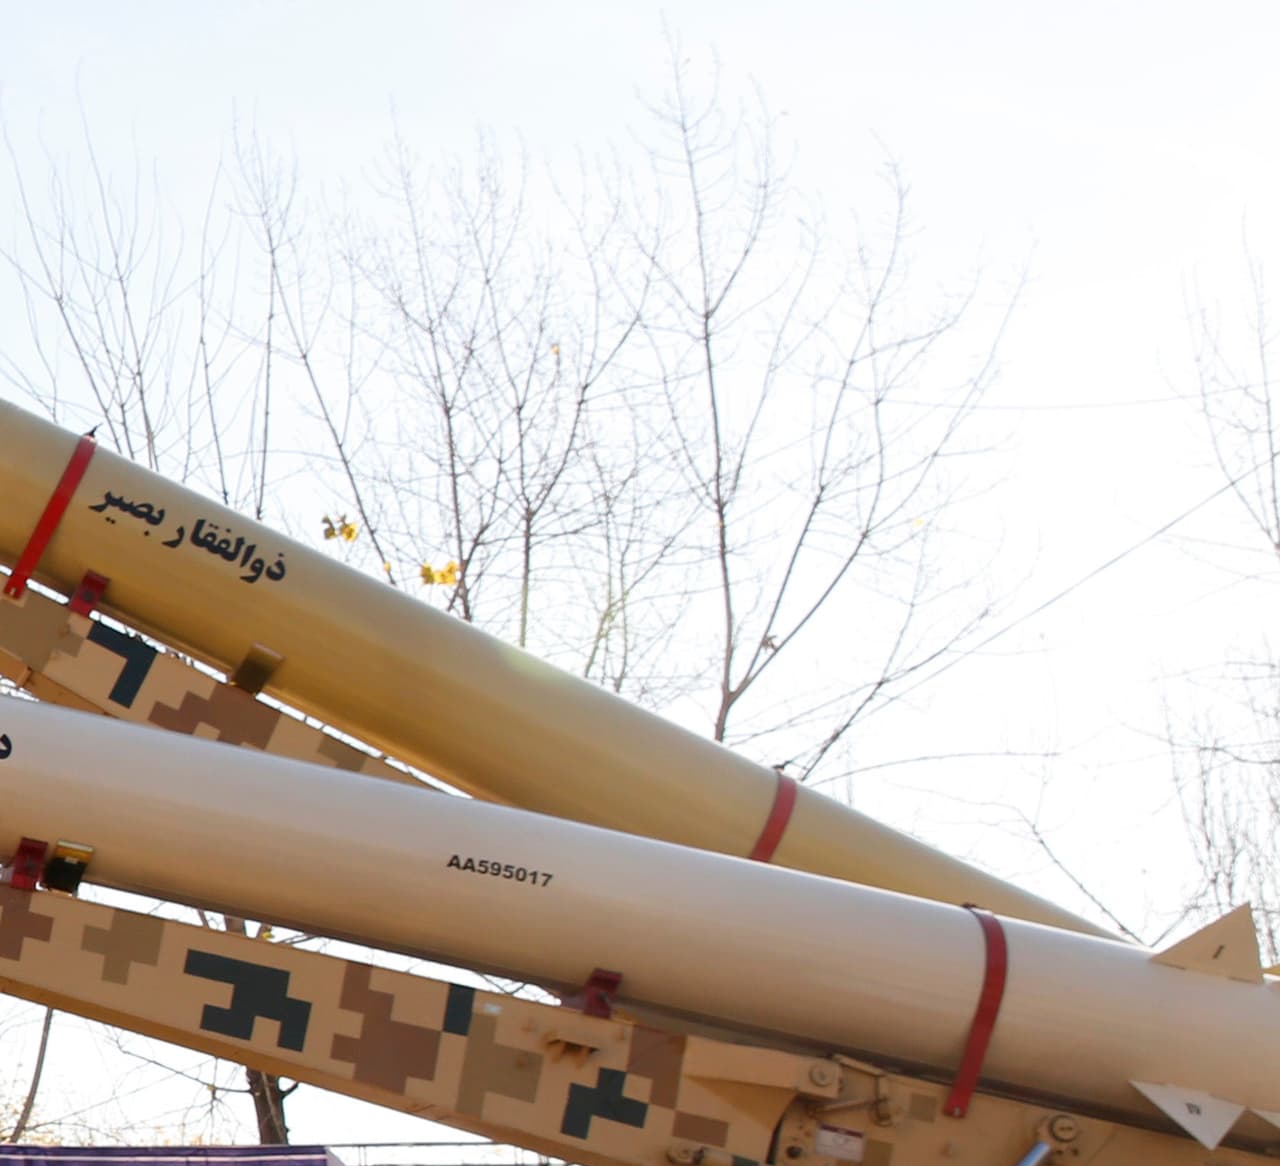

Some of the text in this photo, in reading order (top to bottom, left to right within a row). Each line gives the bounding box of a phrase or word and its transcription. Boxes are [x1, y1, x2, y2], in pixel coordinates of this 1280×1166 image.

[88, 491, 286, 583] ذوالفقار بصیر
[447, 854, 554, 887] AA595017
